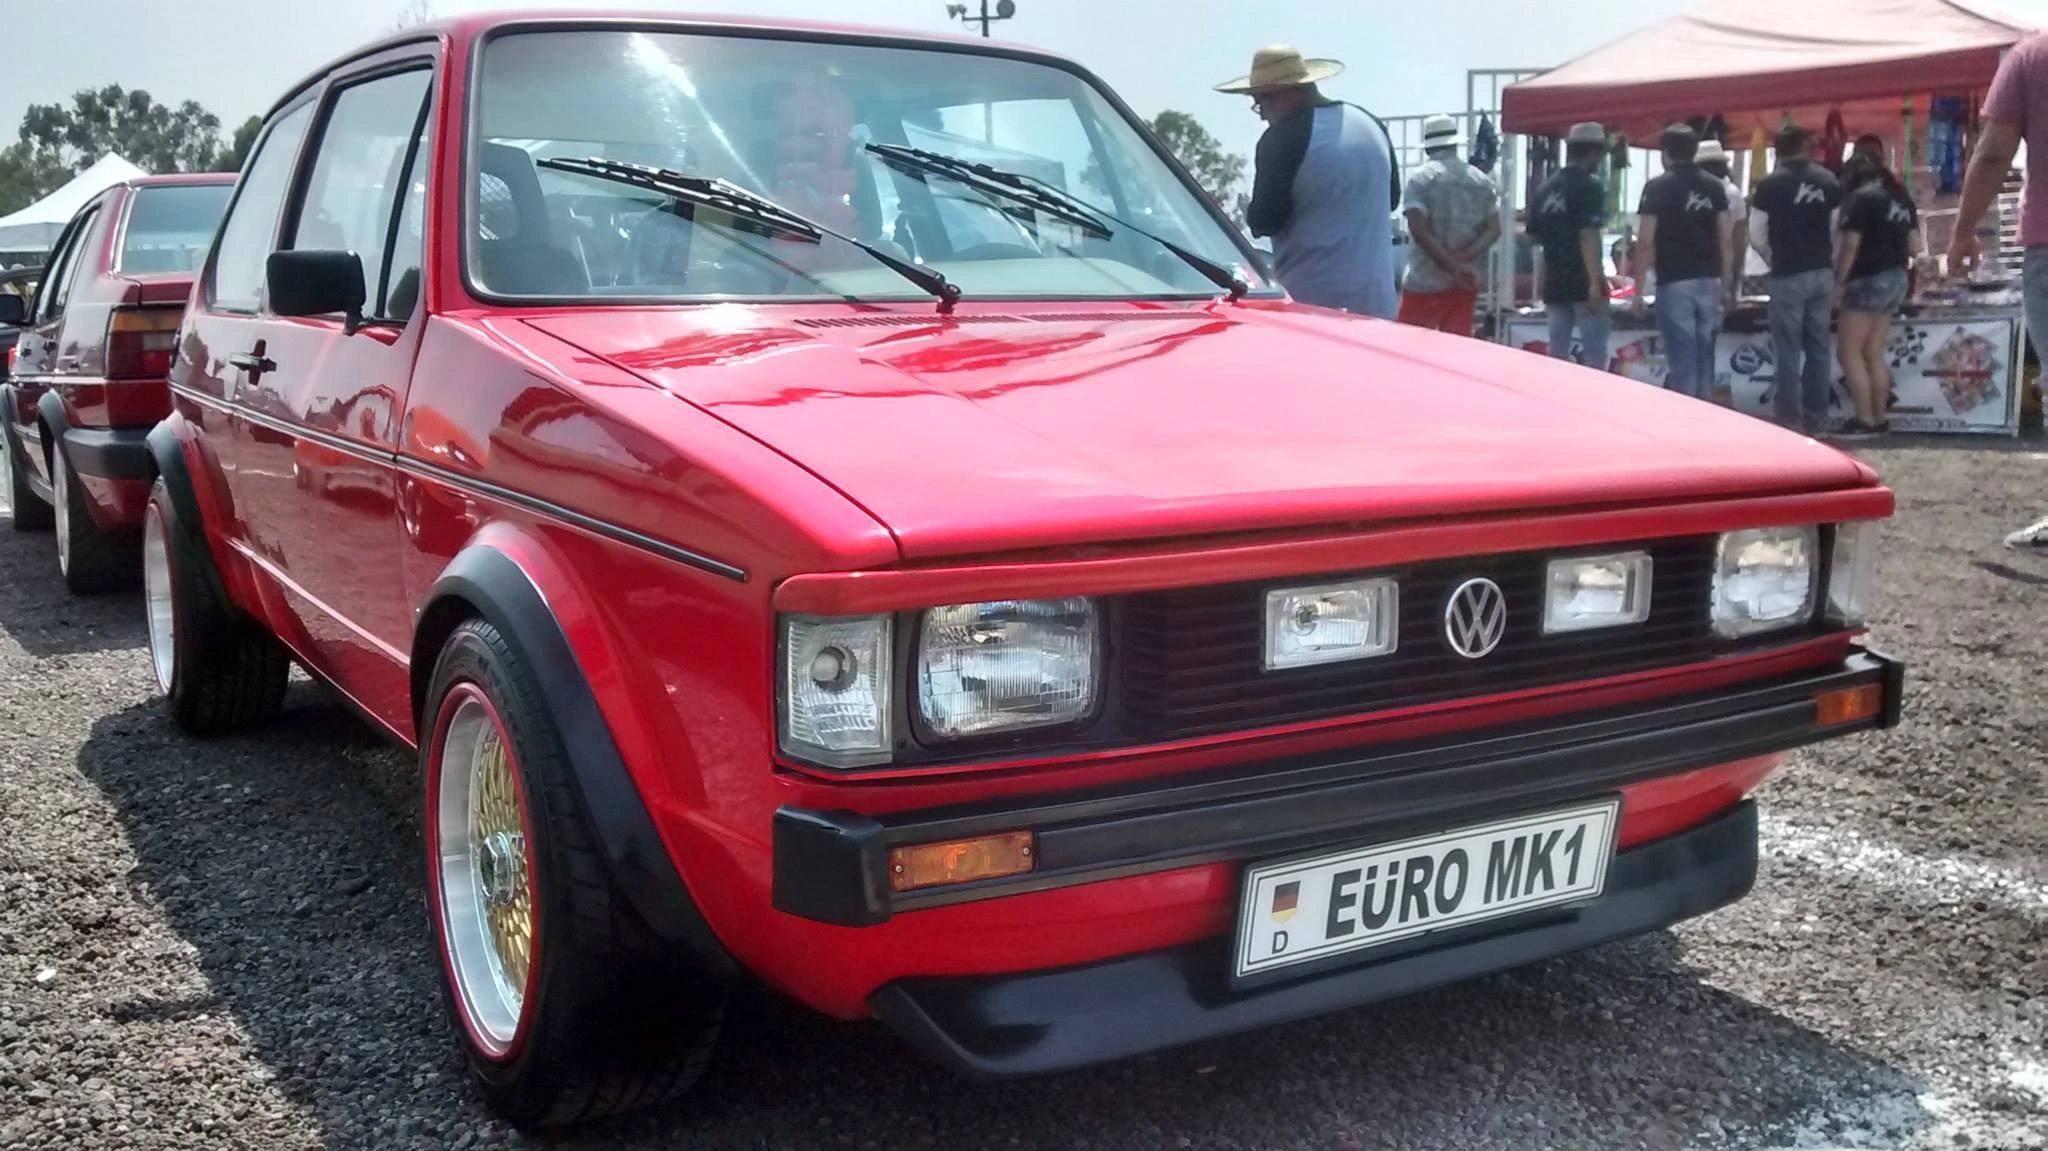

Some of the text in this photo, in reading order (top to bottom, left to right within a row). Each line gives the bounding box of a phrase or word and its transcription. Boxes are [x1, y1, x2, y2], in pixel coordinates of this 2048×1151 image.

[1448, 579, 1505, 656] VW
[1326, 824, 1587, 939] EÜRO MK1
[1271, 930, 1288, 955] D
